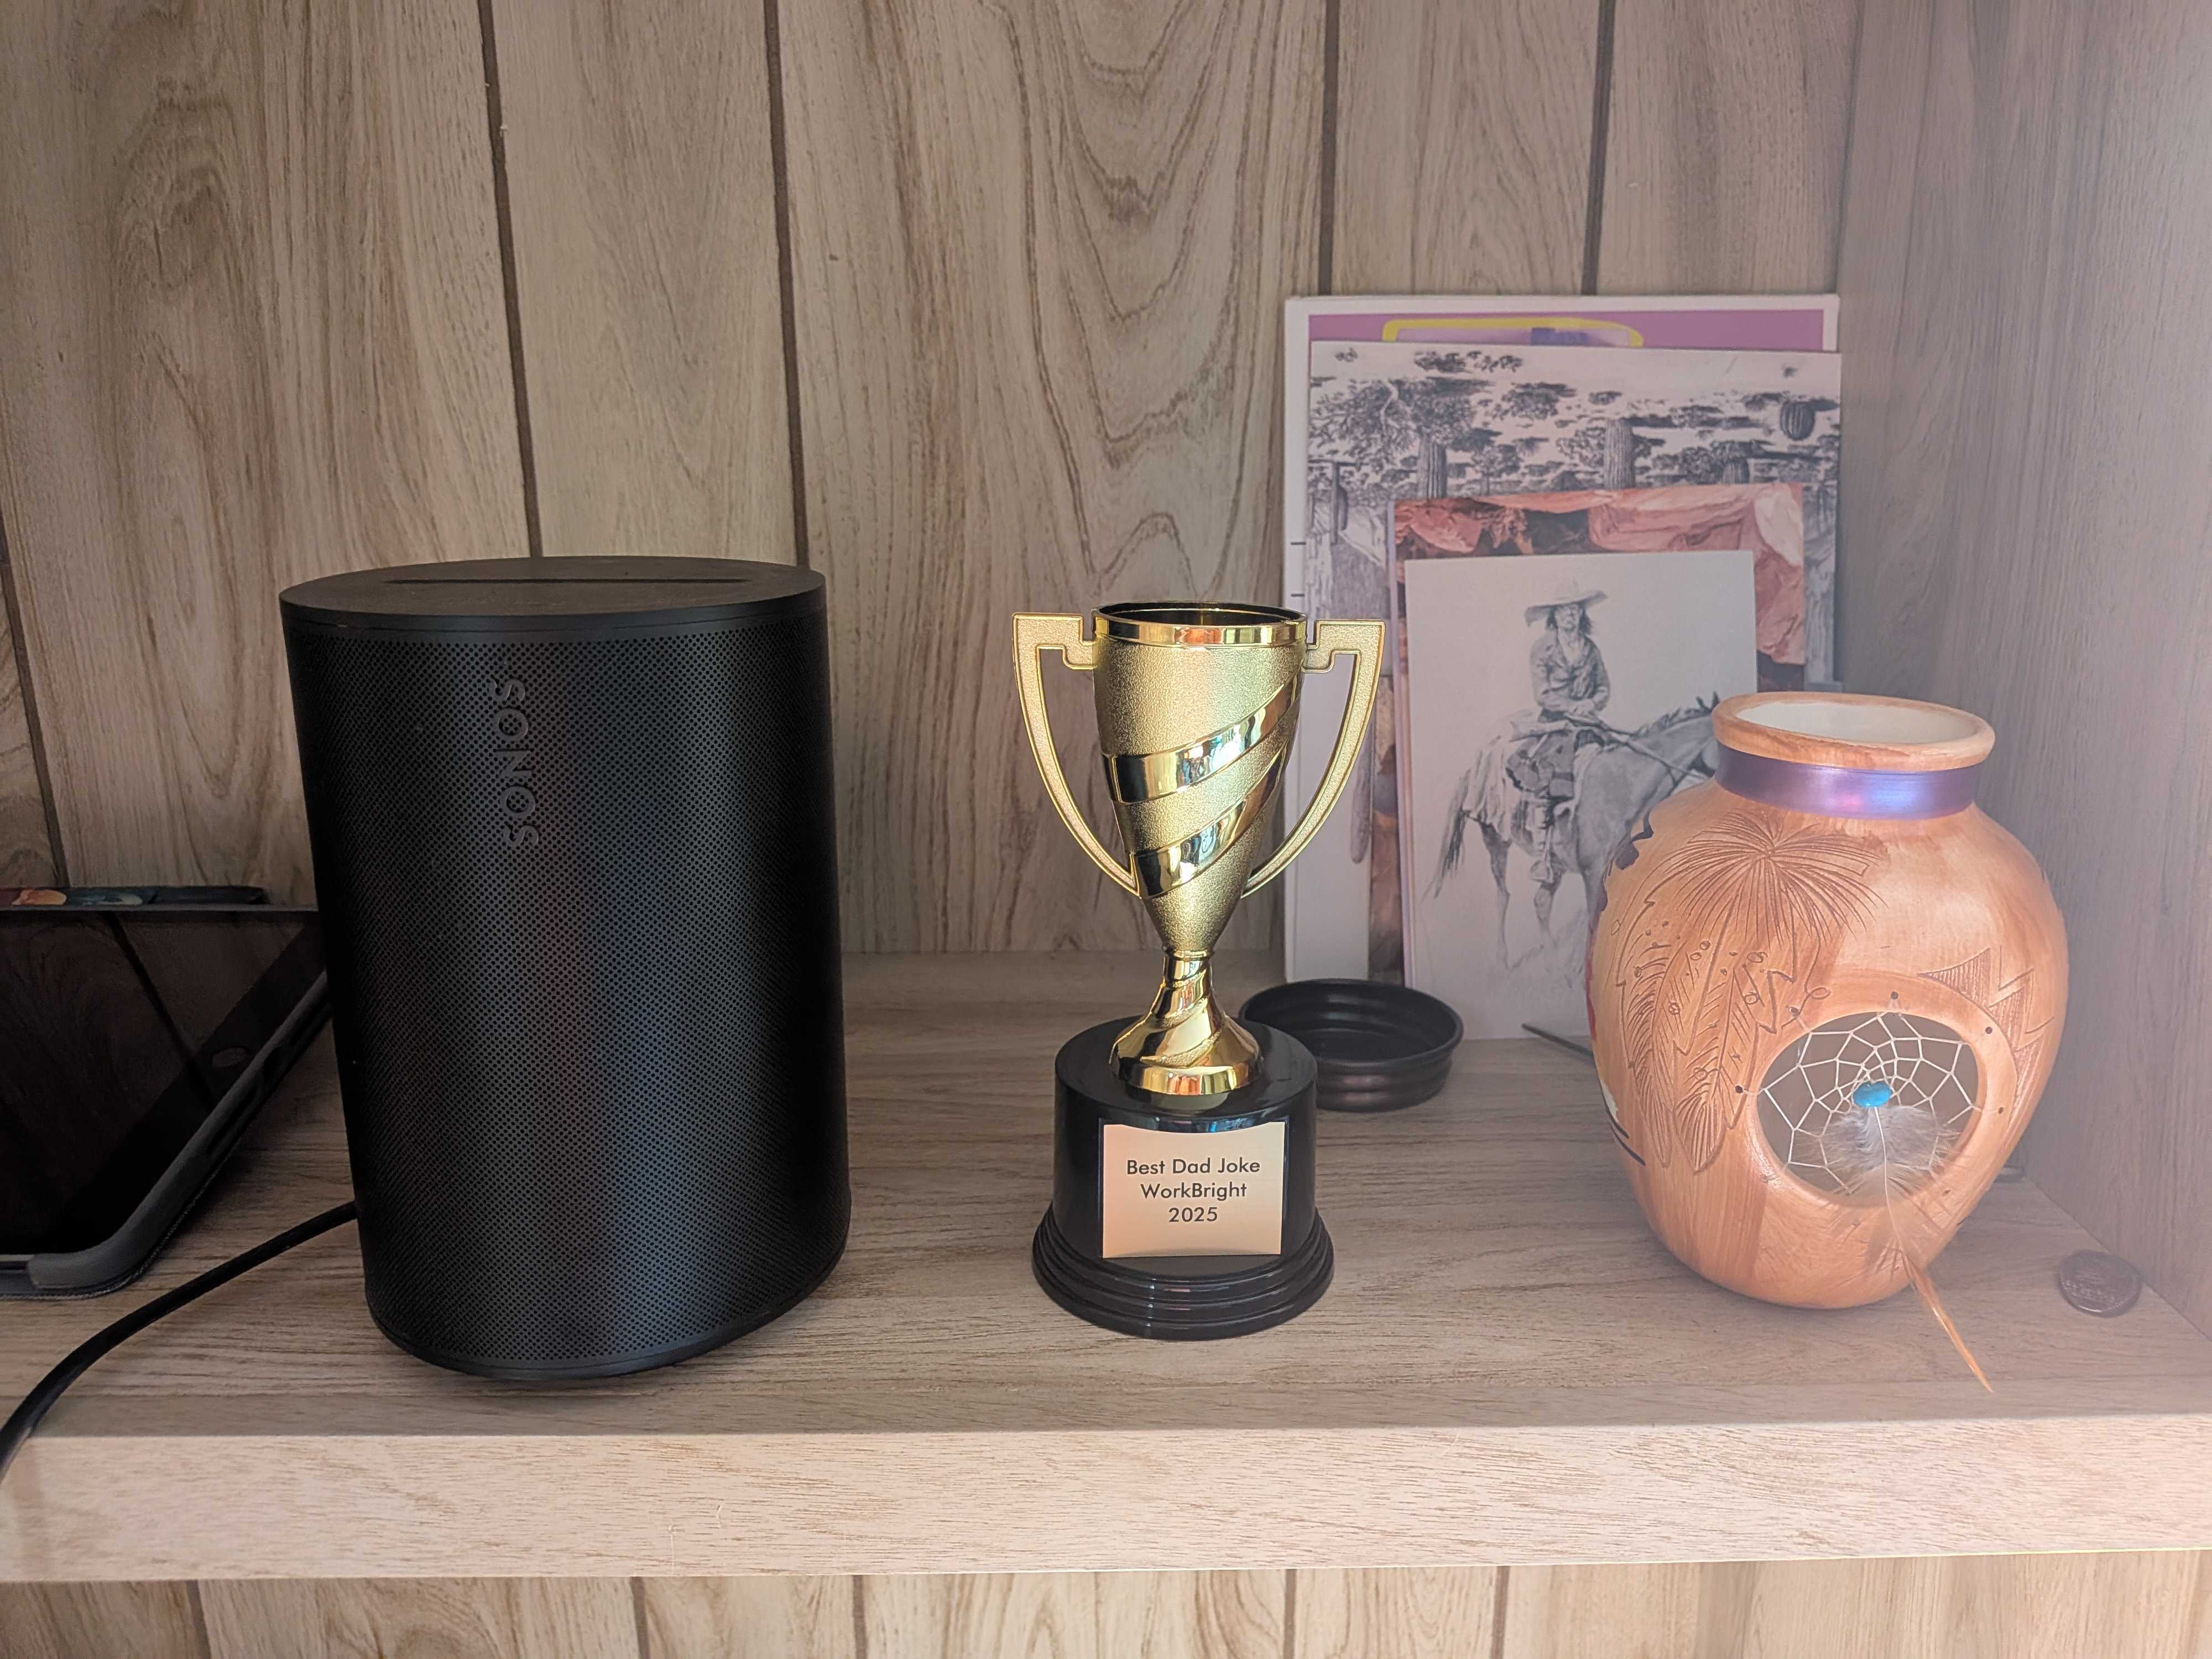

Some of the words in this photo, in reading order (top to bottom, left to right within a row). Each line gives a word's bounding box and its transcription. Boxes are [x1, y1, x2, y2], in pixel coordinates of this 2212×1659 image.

[488, 677, 540, 846] SONOS
[1126, 1159, 1165, 1175] Best
[1172, 1157, 1211, 1173] Dad
[1217, 1157, 1261, 1173] Joke
[1140, 1181, 1247, 1201] WorkBright
[1168, 1207, 1218, 1223] 2025
